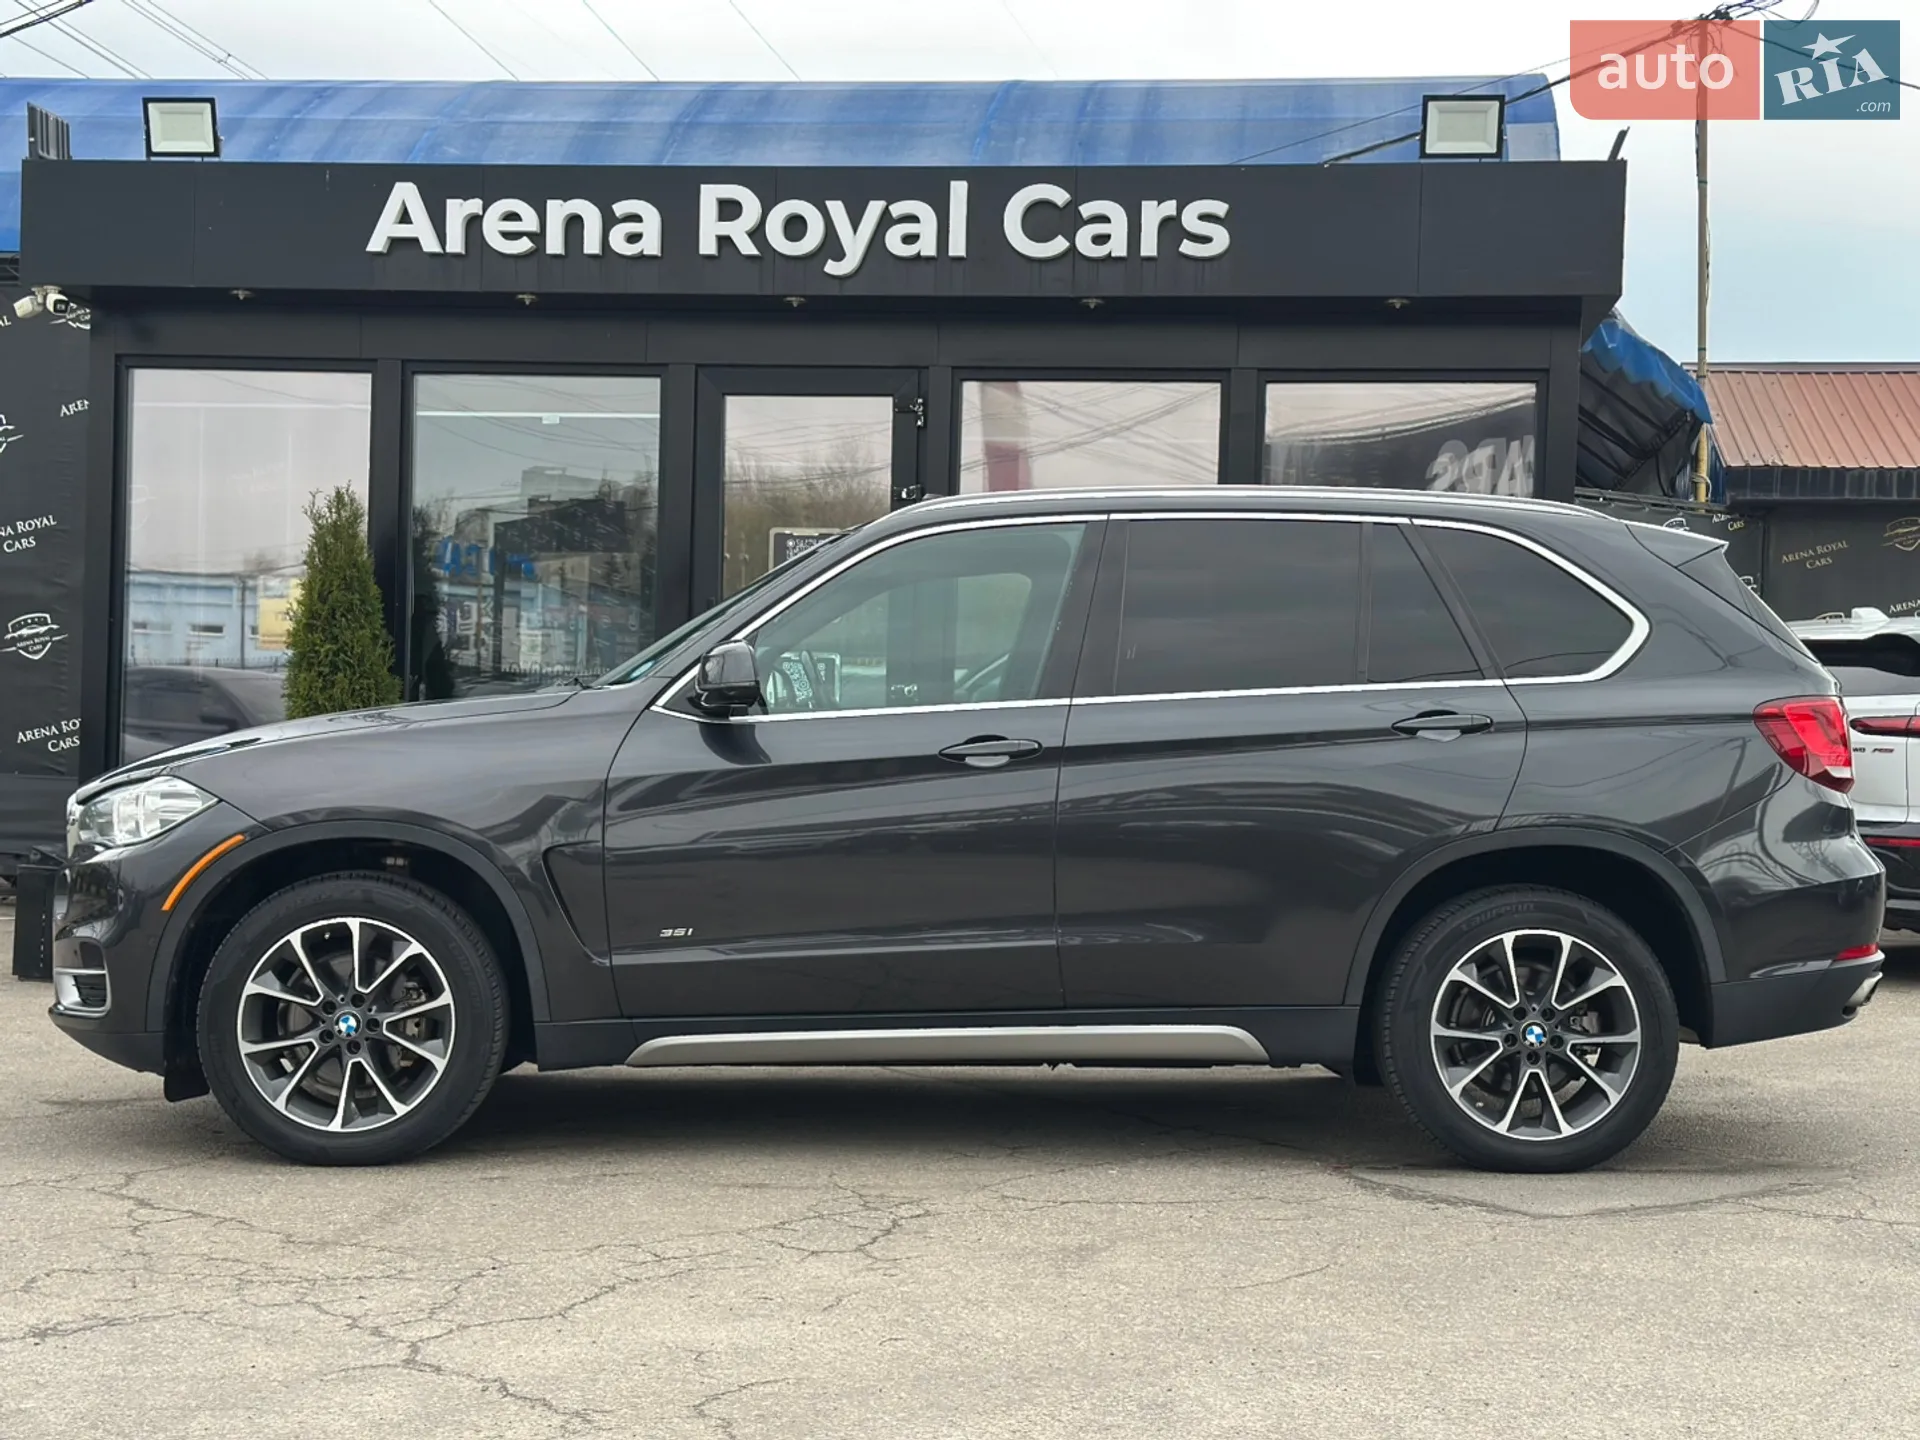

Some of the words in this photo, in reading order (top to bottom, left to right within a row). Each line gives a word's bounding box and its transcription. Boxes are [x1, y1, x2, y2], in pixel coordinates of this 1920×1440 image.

[366, 182, 662, 257] Arena
[698, 180, 969, 276] Royal
[1003, 183, 1231, 259] Cars
[16, 515, 57, 533] ROYAL
[3, 536, 36, 553] CARS
[1782, 549, 1815, 564] ARENA
[1816, 540, 1849, 555] ROYAL
[1806, 556, 1833, 569] CARS
[17, 725, 60, 744] ARENA
[61, 717, 82, 733] RO
[47, 735, 80, 752] CARS
